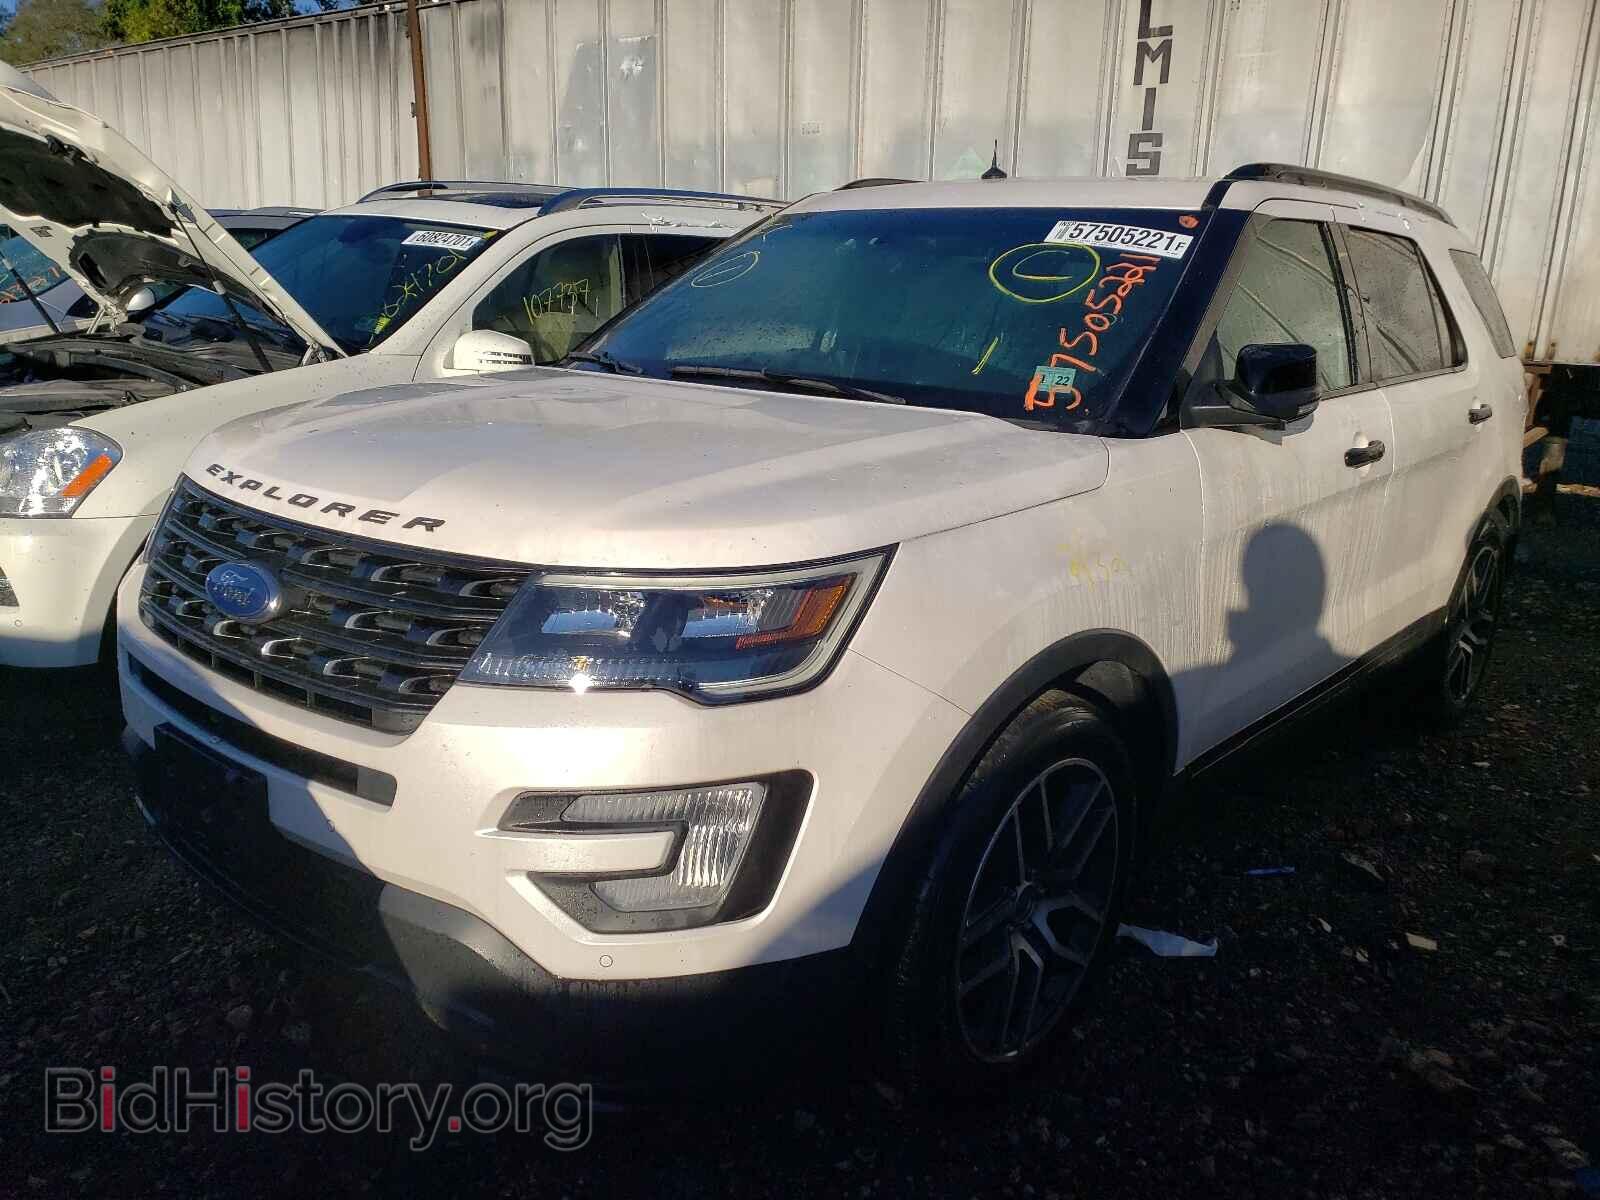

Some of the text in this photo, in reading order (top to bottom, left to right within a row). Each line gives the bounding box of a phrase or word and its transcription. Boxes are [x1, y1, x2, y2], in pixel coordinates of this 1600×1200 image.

[1068, 223, 1177, 251] 57505221
[1055, 375, 1070, 386] 22
[206, 463, 446, 532] EXPLORER
[211, 569, 256, 606] Ford
